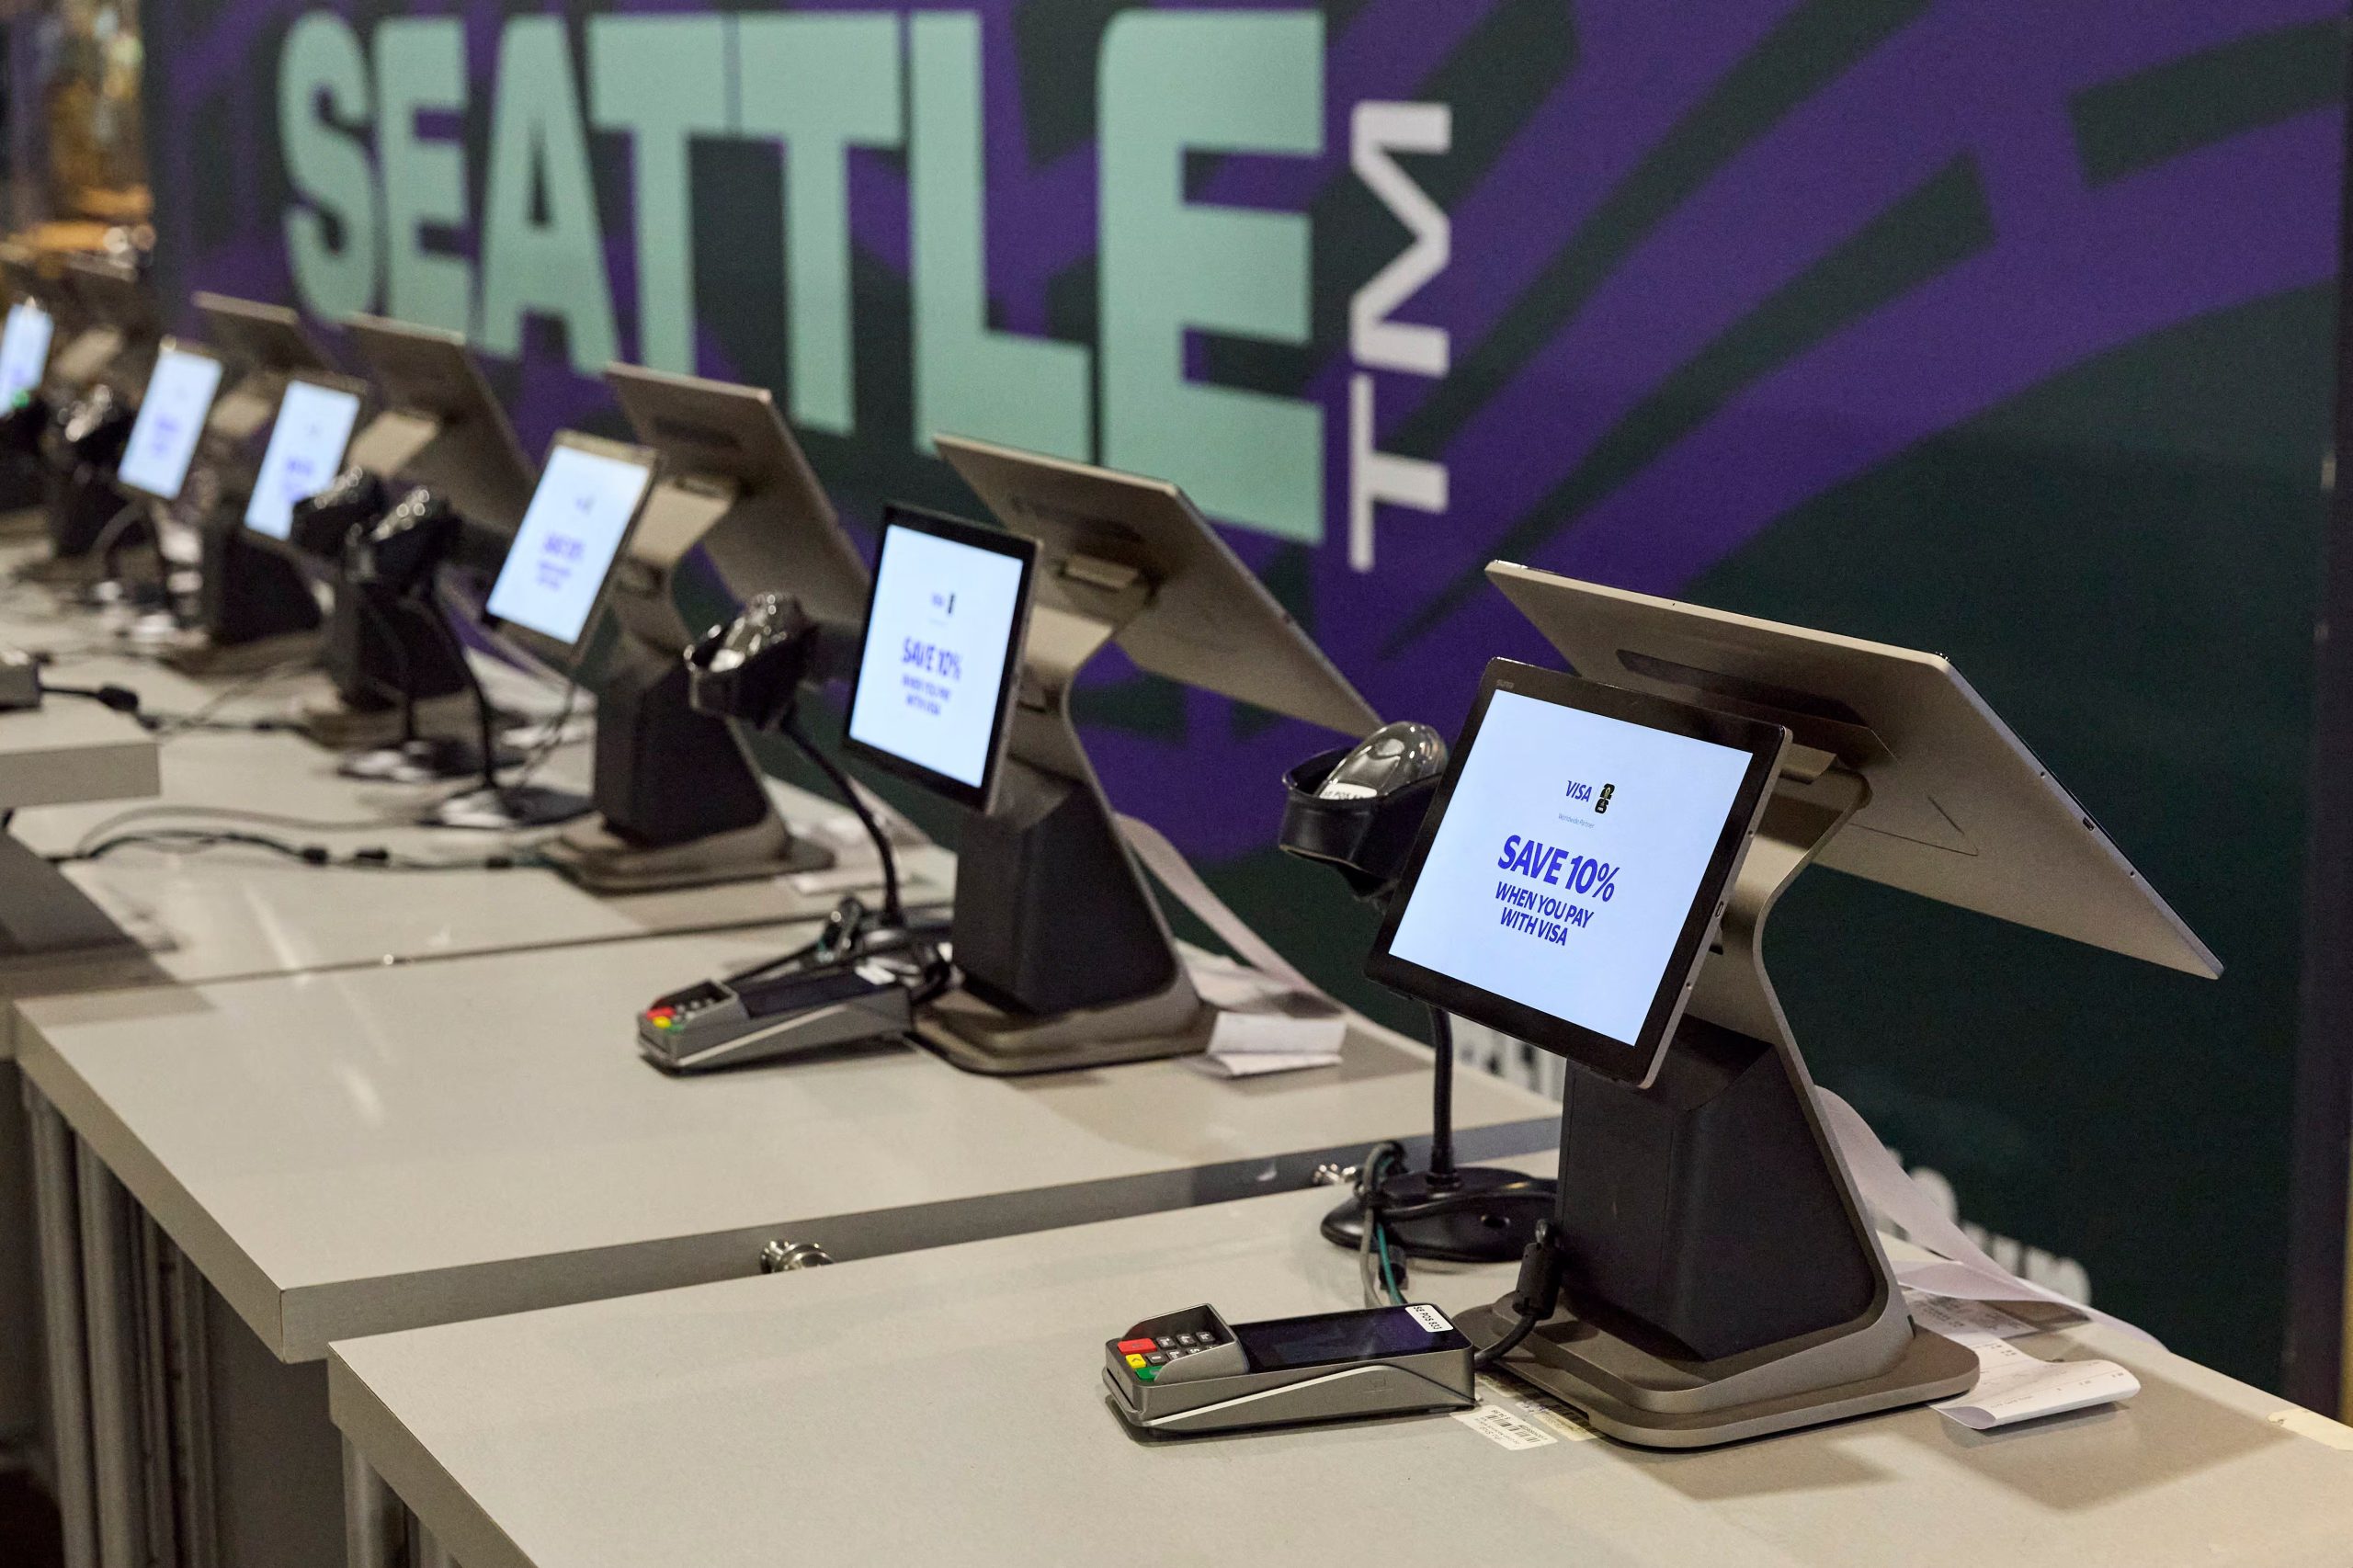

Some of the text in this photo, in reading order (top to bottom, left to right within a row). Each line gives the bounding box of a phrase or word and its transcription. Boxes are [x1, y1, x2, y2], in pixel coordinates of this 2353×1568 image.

[278, 8, 1326, 545] SEATTLE
[1350, 99, 1451, 572] TM
[1565, 780, 1592, 802] VISA
[1497, 835, 1620, 903] SAVE 10%
[1495, 881, 1595, 928] WHEN YOU PAY
[1500, 906, 1568, 946] WITH VISA
